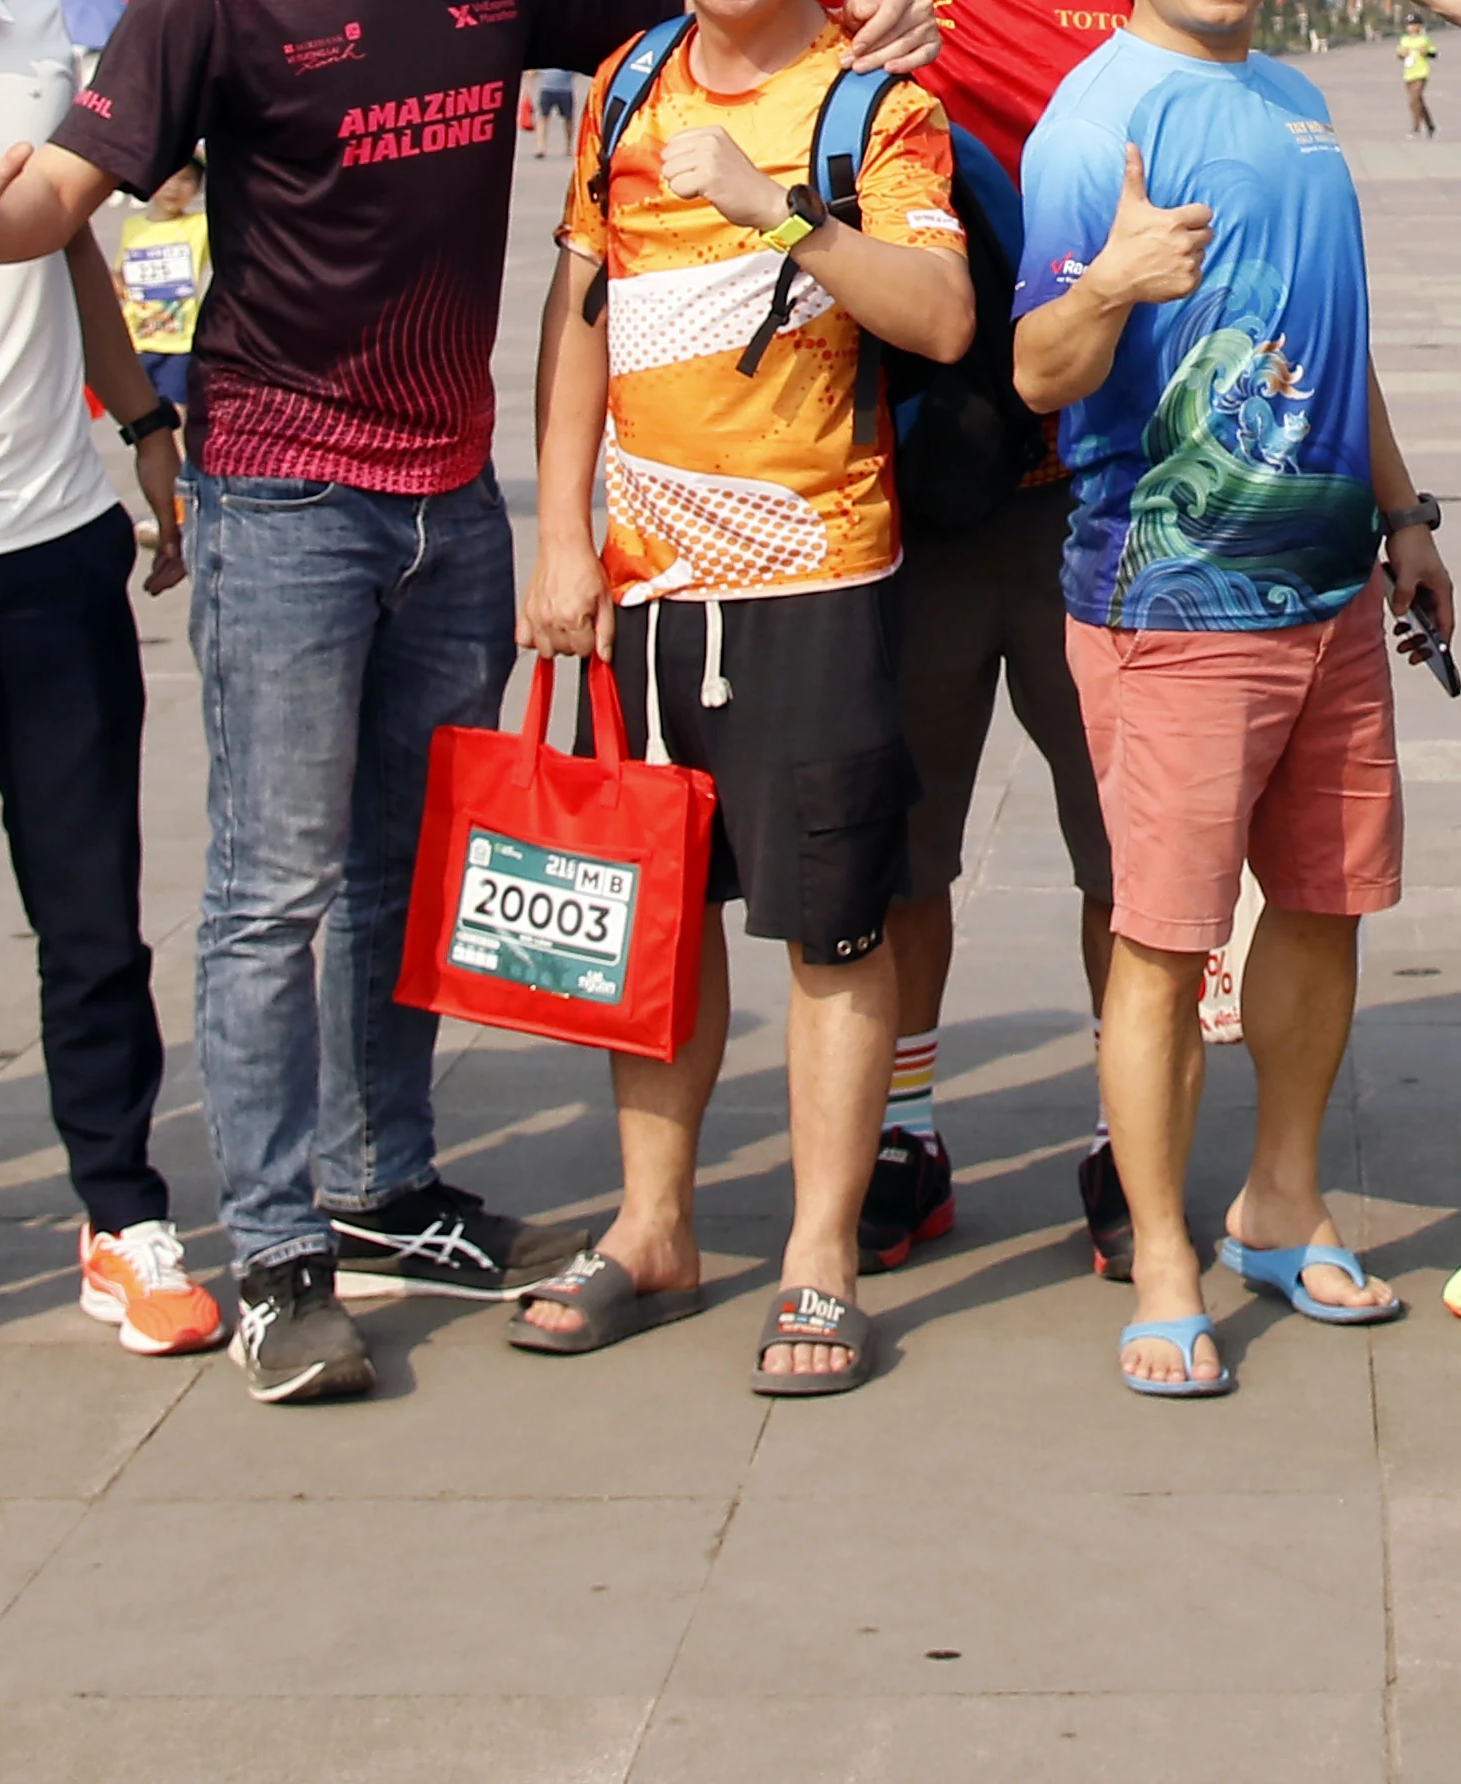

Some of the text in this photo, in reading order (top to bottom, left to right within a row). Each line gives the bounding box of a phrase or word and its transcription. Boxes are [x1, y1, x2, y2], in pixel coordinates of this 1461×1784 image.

[1054, 9, 1130, 30] TOTO
[337, 81, 504, 138] AMAZING
[342, 113, 495, 167] HALONG
[582, 871, 601, 890] M
[610, 875, 624, 894] B
[475, 879, 611, 943] 20003
[799, 1288, 846, 1322] Doir
